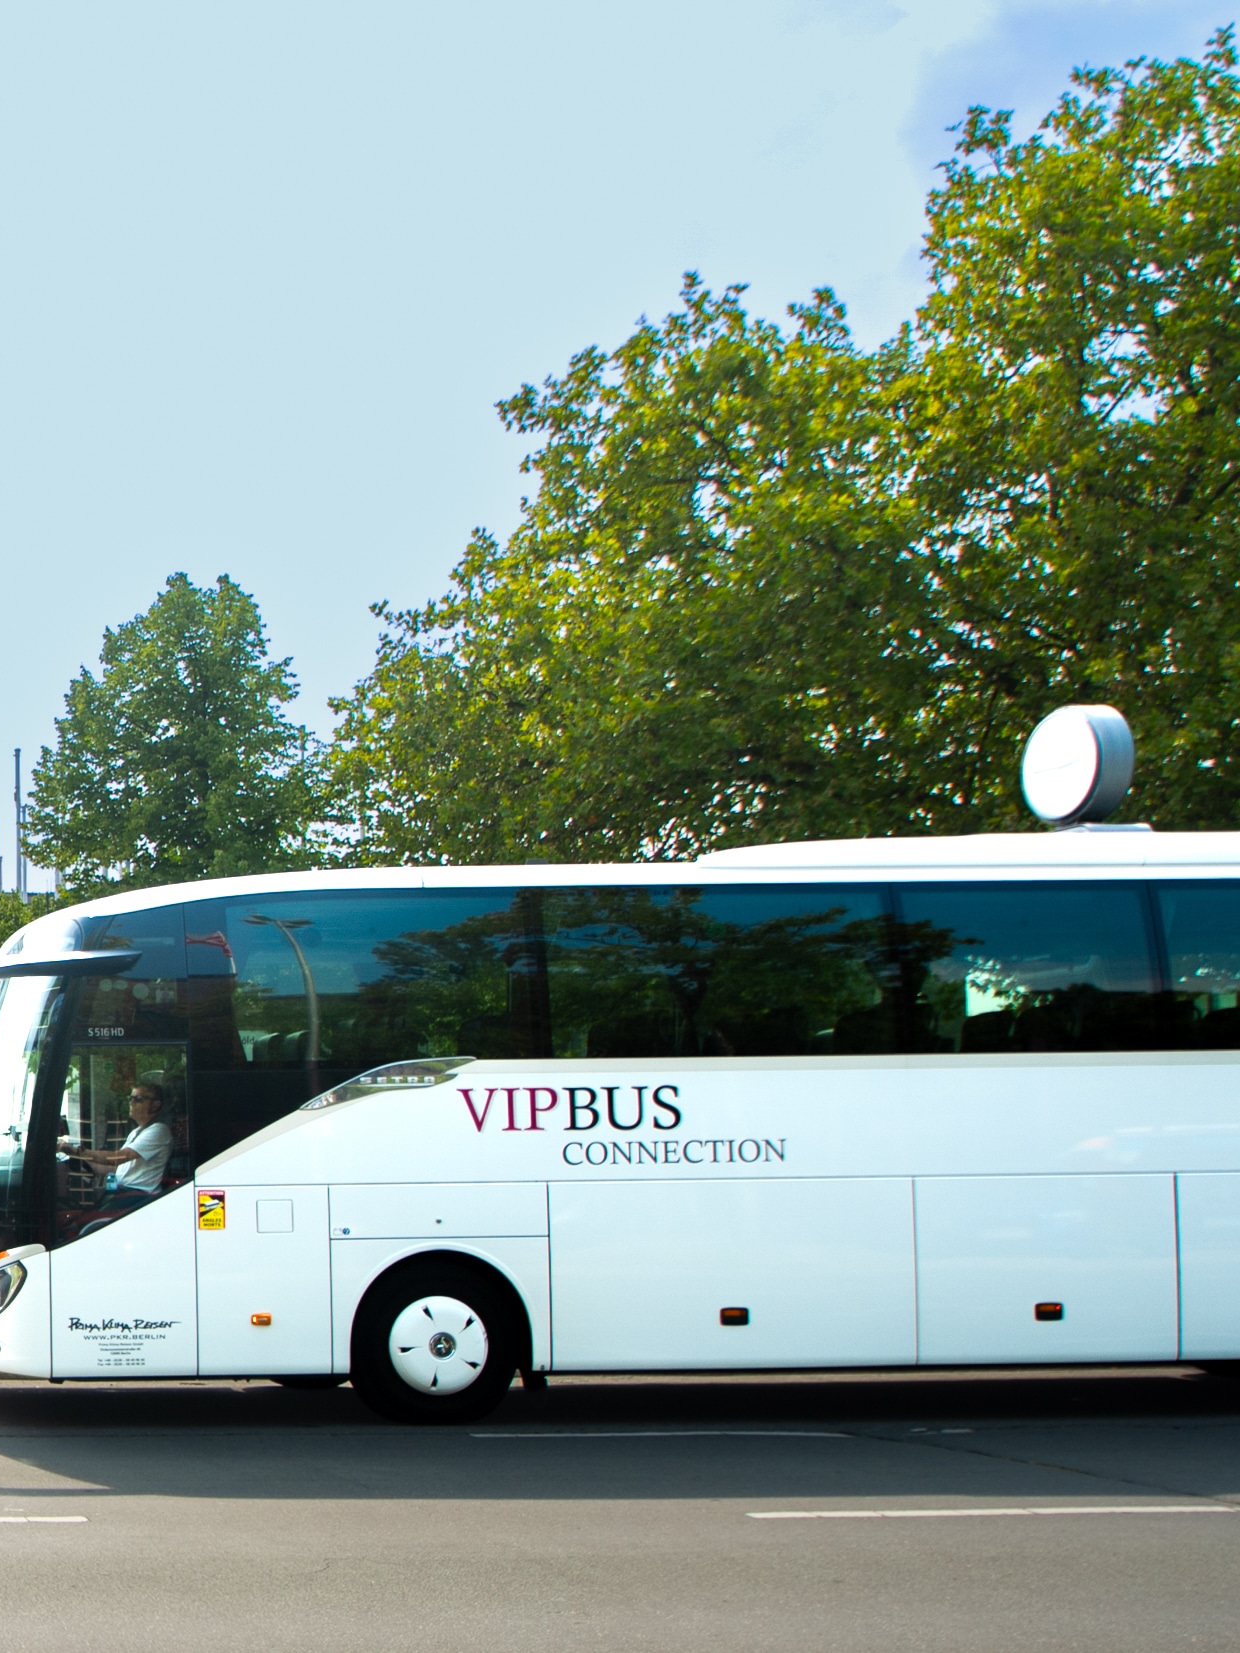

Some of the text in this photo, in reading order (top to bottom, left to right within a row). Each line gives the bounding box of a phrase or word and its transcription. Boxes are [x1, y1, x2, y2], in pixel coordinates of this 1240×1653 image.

[95, 1027, 109, 1037] 516
[111, 1027, 125, 1037] HD
[457, 1084, 682, 1133] VIPBUS
[562, 1138, 786, 1167] CONNECTION
